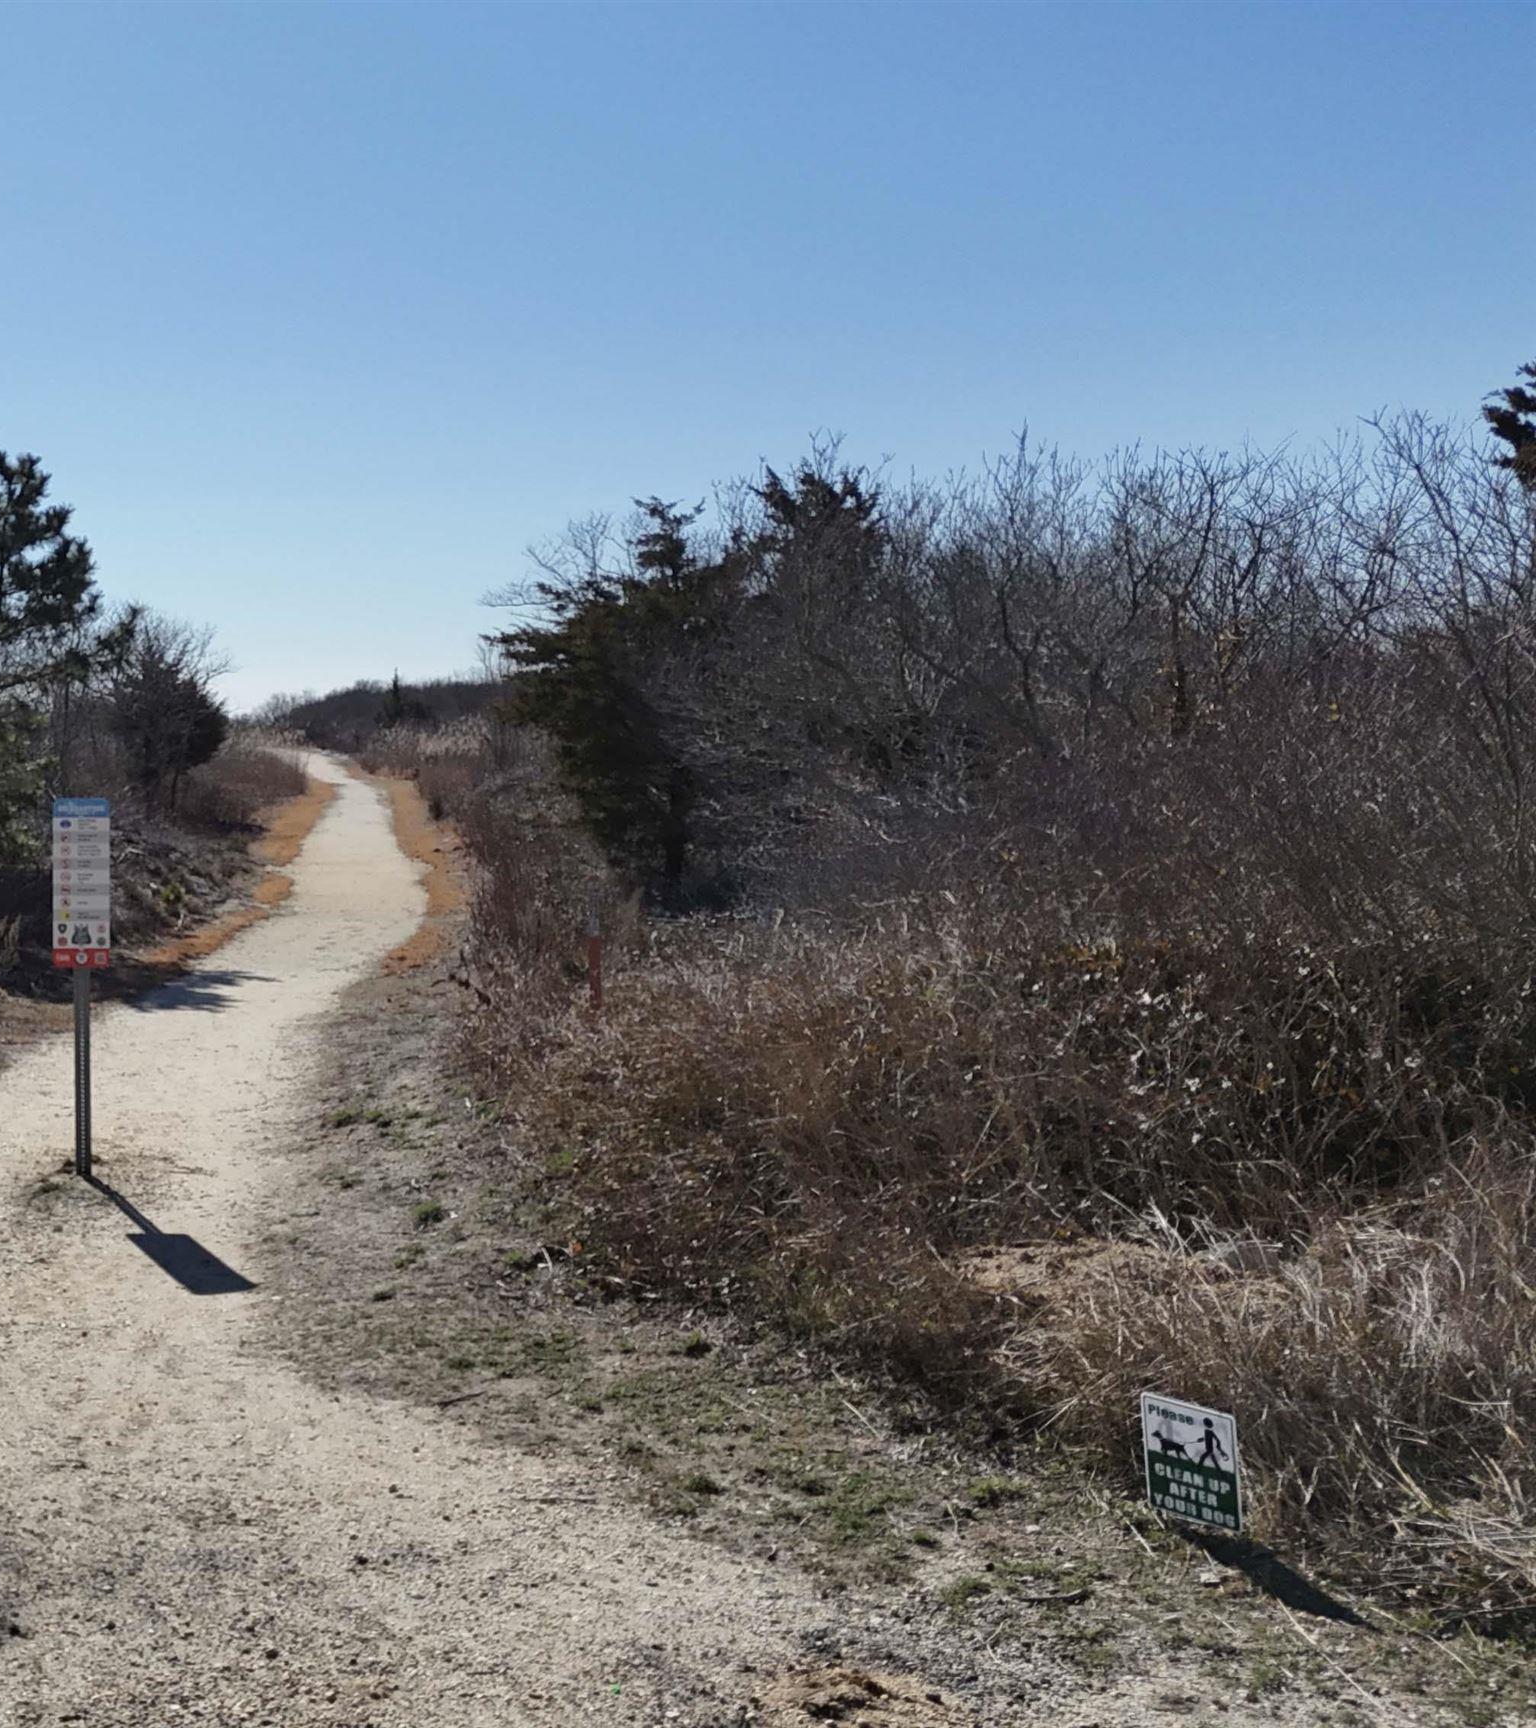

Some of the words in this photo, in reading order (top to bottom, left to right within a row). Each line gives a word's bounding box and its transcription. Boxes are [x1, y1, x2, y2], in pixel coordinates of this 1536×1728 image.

[1148, 1404, 1194, 1425] Please
[1154, 1463, 1204, 1488] CLEAN
[1209, 1479, 1231, 1494] UP
[1169, 1482, 1218, 1507] AFTER
[1153, 1492, 1197, 1516] YOUR
[1201, 1507, 1235, 1527] DOG
